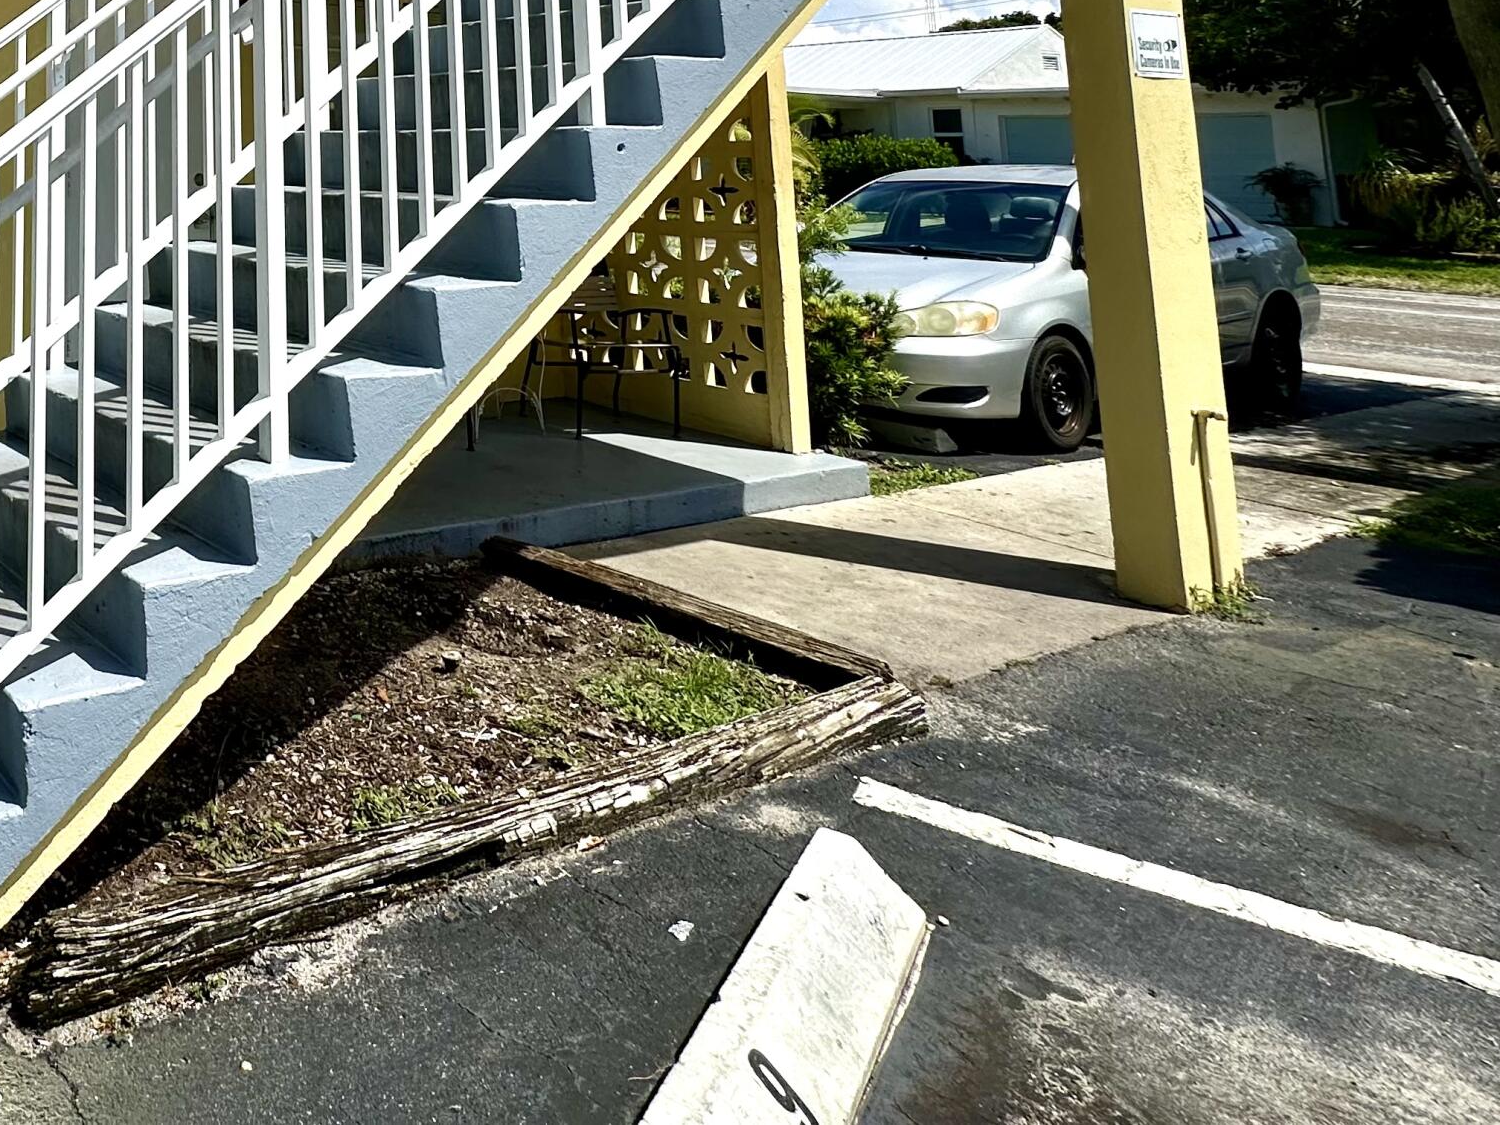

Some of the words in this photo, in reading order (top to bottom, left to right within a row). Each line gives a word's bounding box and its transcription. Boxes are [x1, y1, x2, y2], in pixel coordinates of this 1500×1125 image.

[1138, 37, 1162, 54] Security
[1140, 54, 1164, 69] Cameras
[1170, 56, 1180, 70] Use
[747, 1048, 820, 1125] 9
